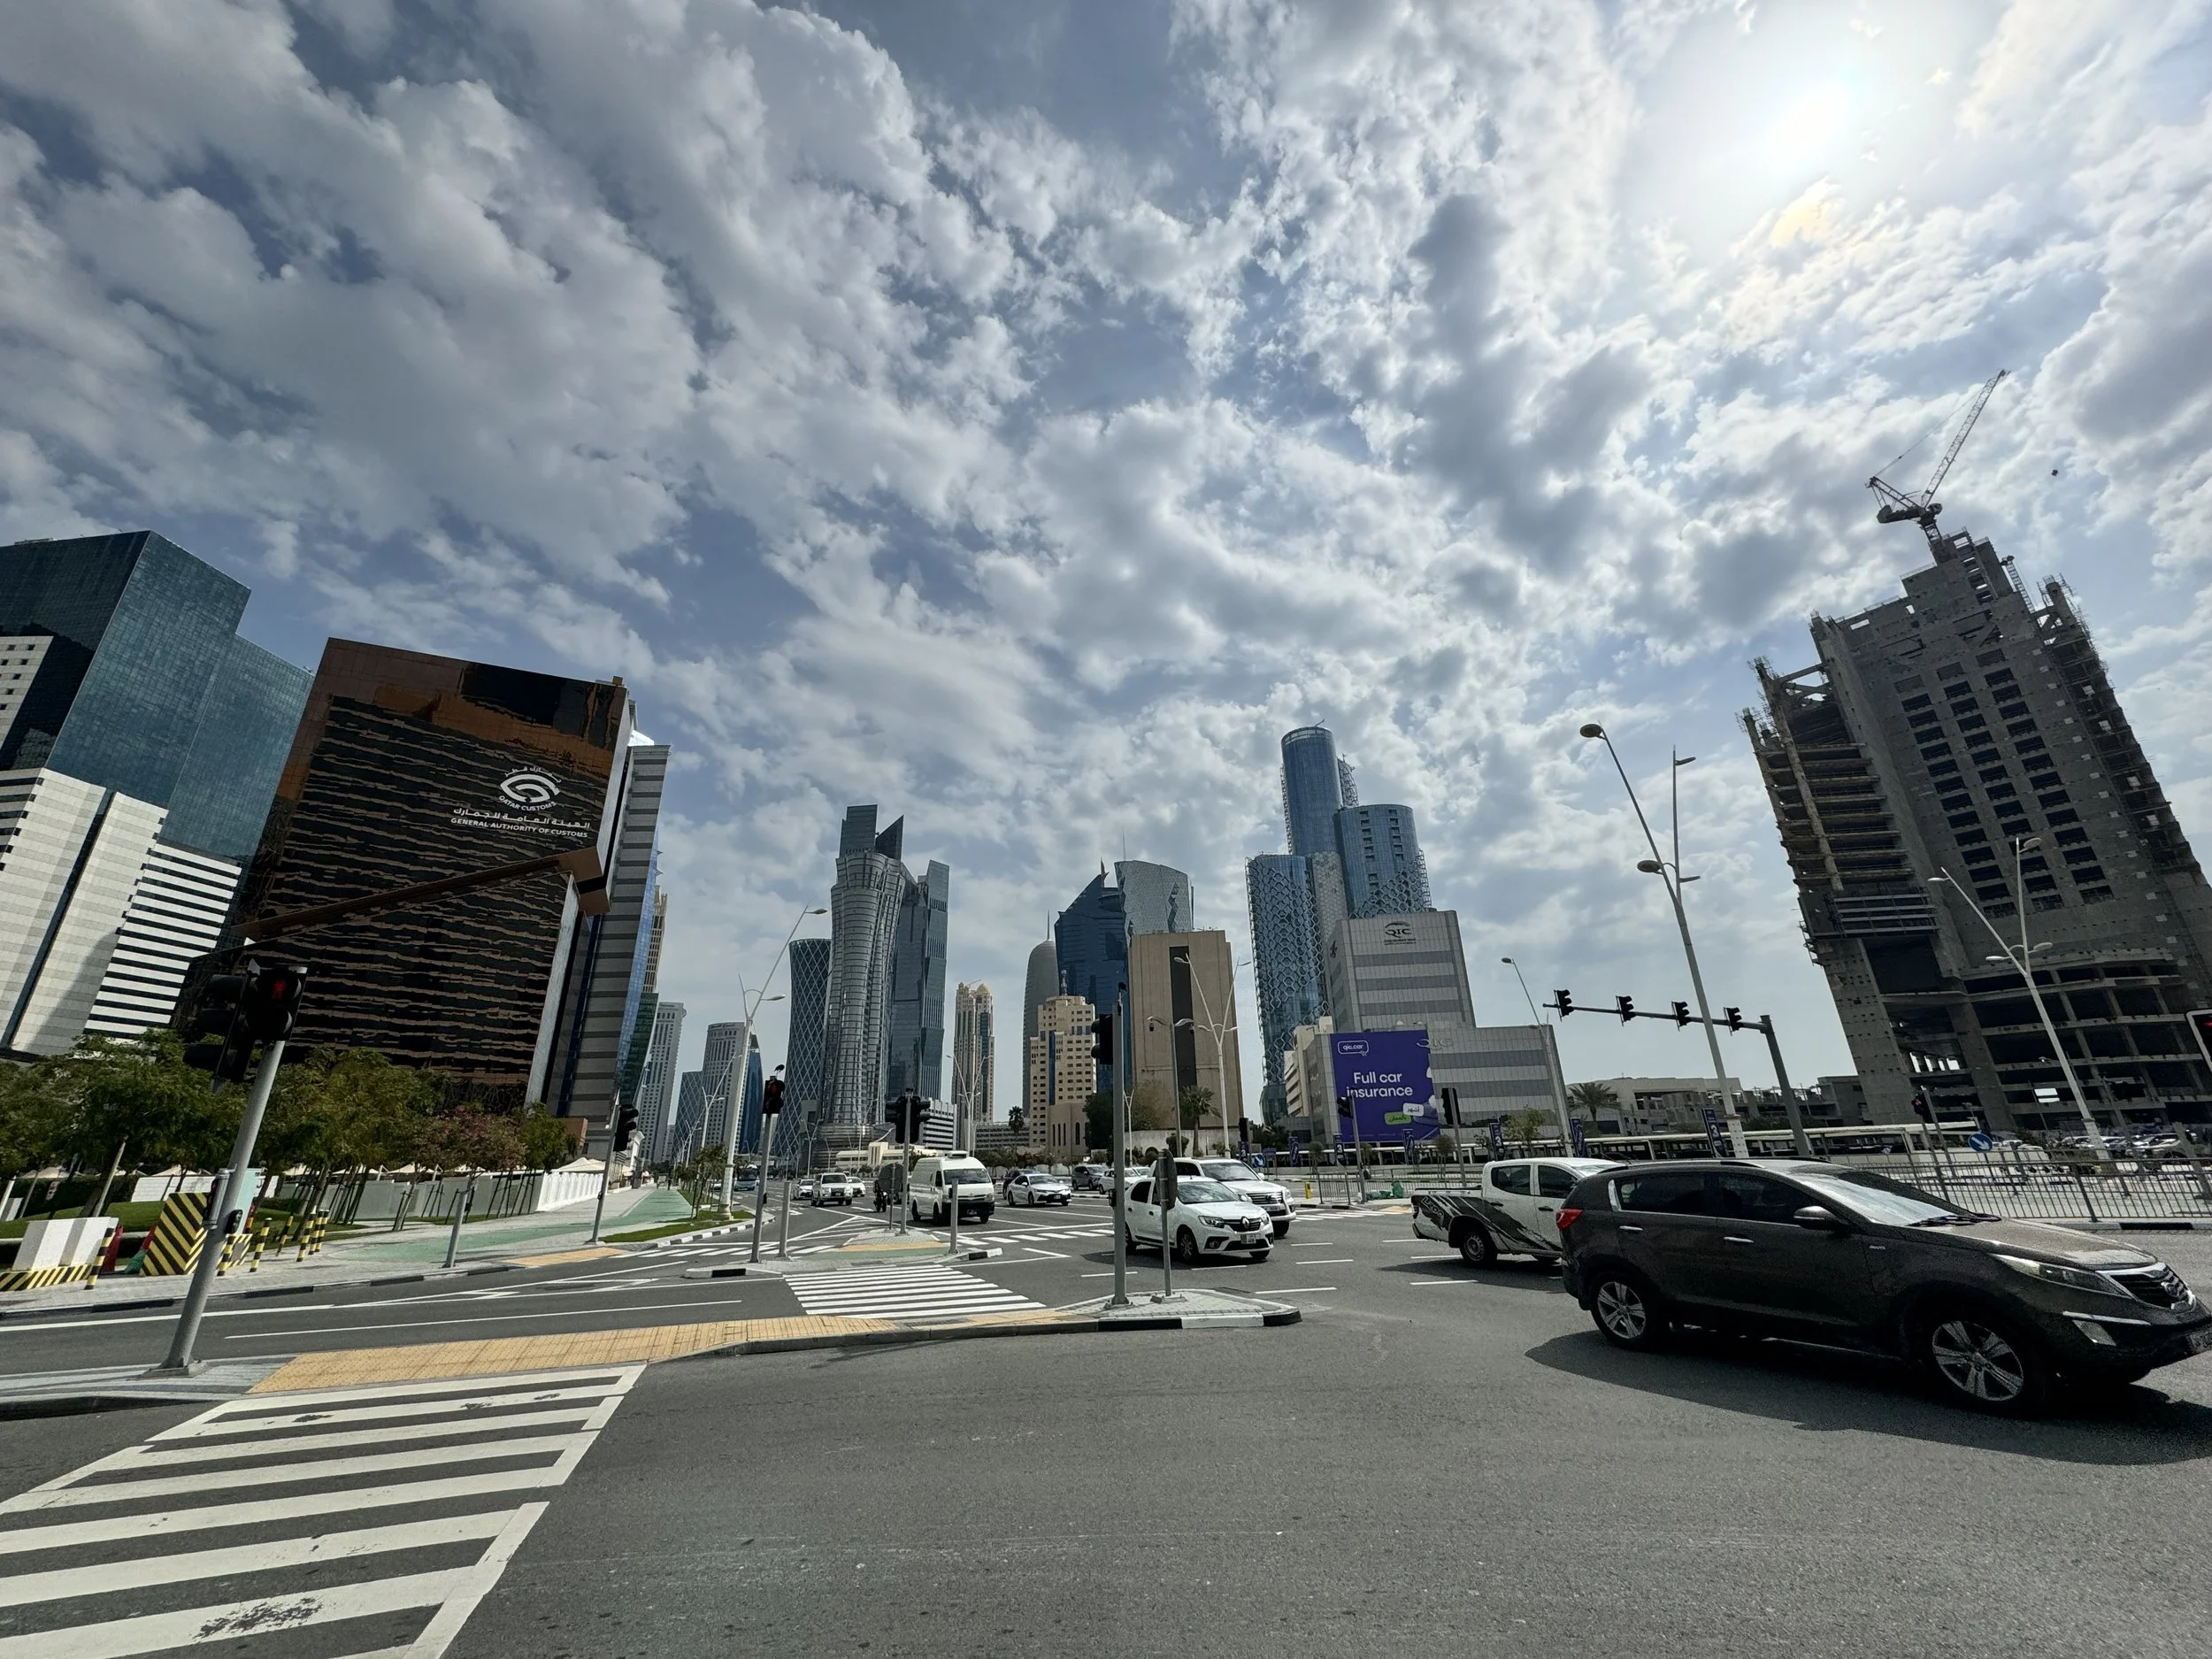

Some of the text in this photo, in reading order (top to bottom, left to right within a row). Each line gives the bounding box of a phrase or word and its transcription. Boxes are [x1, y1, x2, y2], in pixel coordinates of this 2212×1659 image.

[499, 795, 557, 811] QATAR CUSTOMS
[453, 808, 590, 829] الهيئة العامة للجمارك
[450, 818, 488, 827] GENERAL
[490, 823, 536, 833] AUTHORITY
[550, 829, 588, 838] CUSTOMS
[1385, 929, 1412, 938] QIC
[1353, 1071, 1402, 1084] Full car
[1346, 1087, 1413, 1098] insurance
